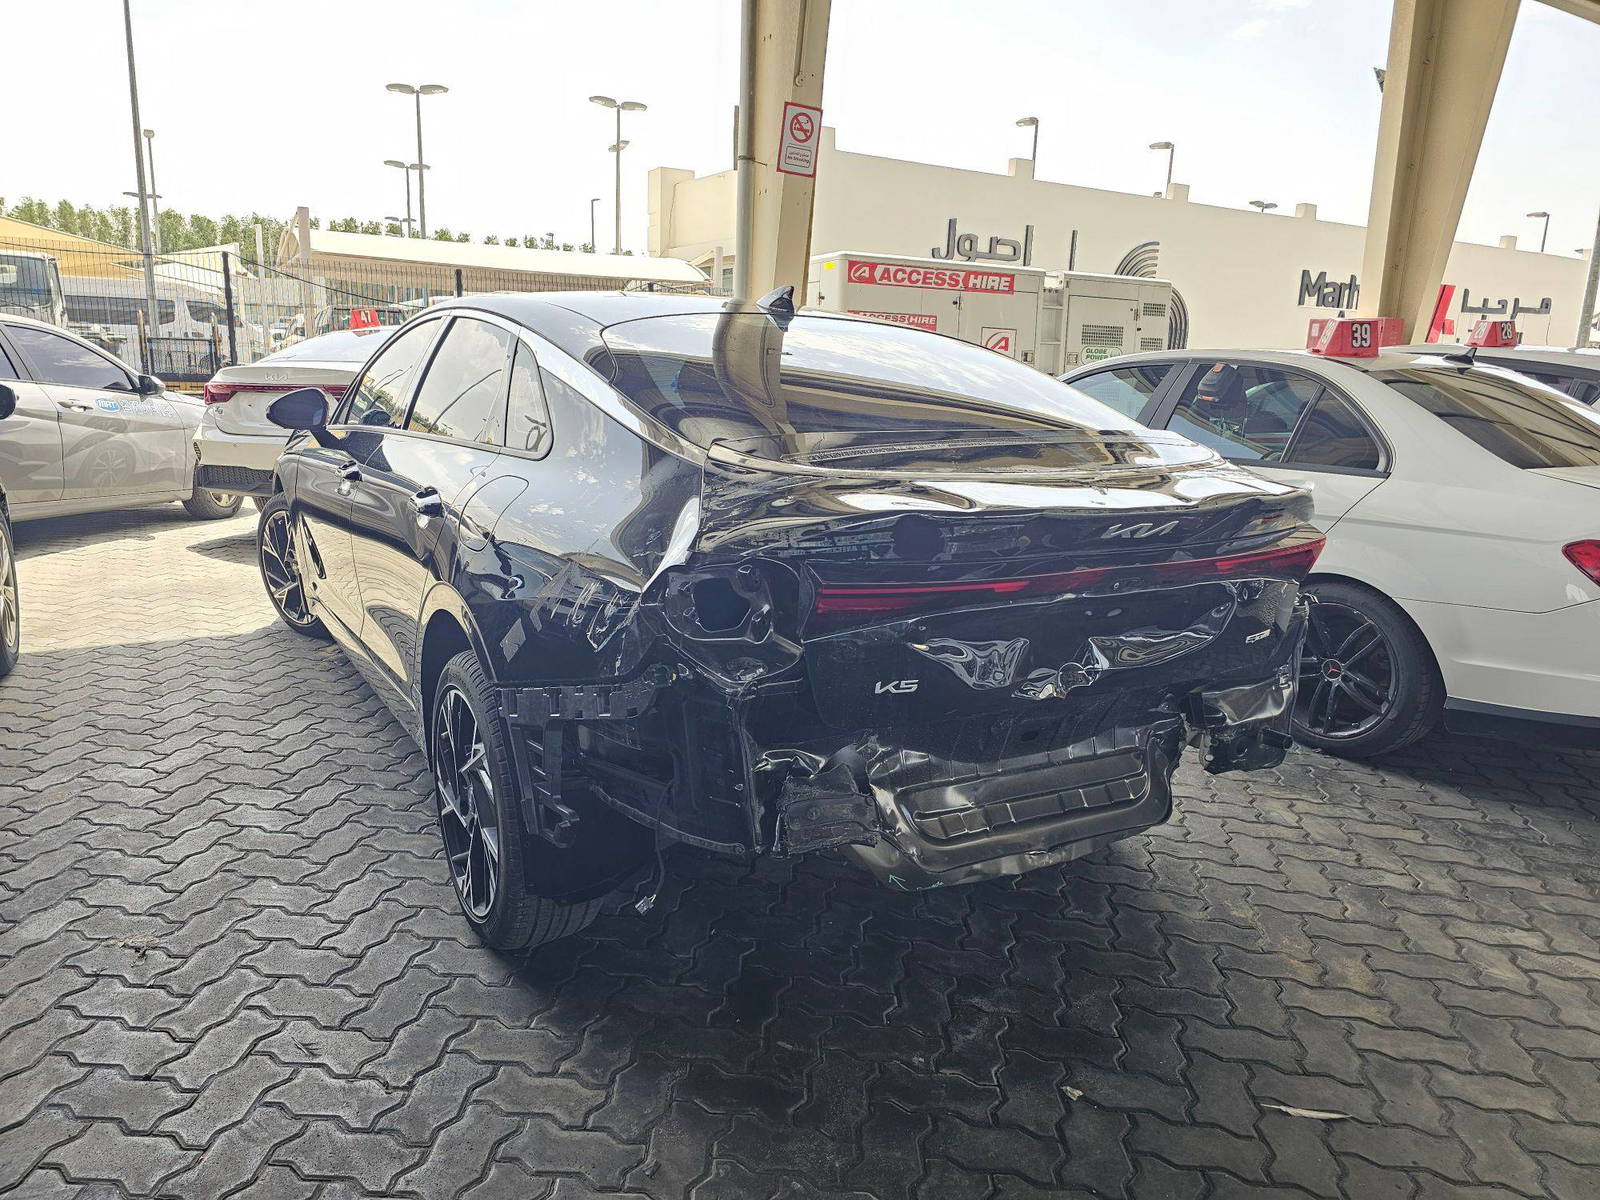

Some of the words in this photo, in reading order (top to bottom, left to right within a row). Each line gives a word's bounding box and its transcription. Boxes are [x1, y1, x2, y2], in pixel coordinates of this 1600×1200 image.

[878, 267, 961, 288] ACCESS
[968, 274, 1011, 291] HIRE
[1461, 288, 1552, 320] مرحبا
[360, 310, 372, 323] 47
[909, 316, 936, 324] HIRE
[1352, 323, 1371, 348] 39
[1501, 322, 1513, 340] 28
[1101, 520, 1179, 539] KIA
[874, 679, 919, 694] K5
